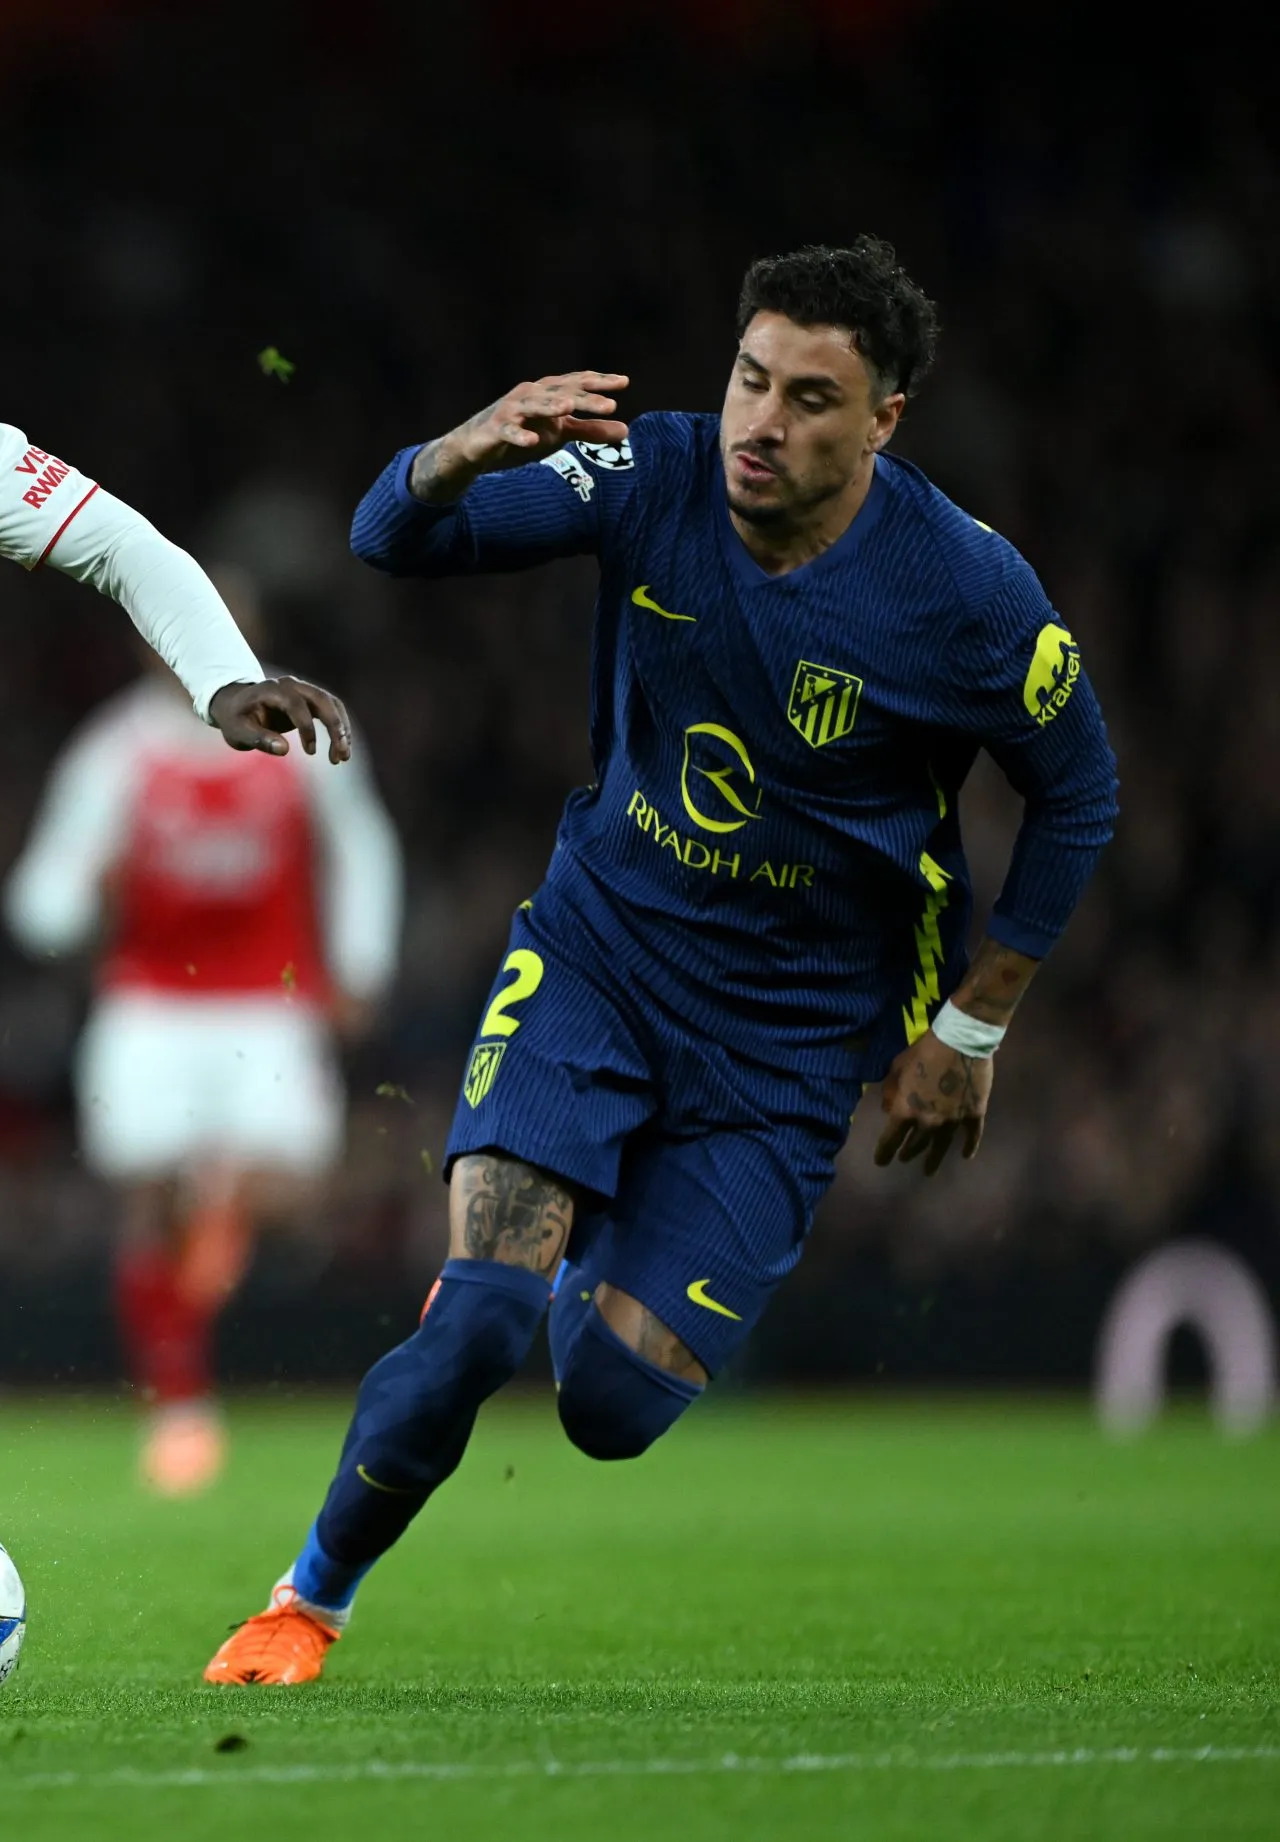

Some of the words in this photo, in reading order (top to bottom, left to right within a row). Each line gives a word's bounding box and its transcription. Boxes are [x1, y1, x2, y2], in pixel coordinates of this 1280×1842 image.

[626, 789, 741, 878] RIYADH
[750, 860, 815, 889] AIR
[480, 948, 545, 1038] 2
